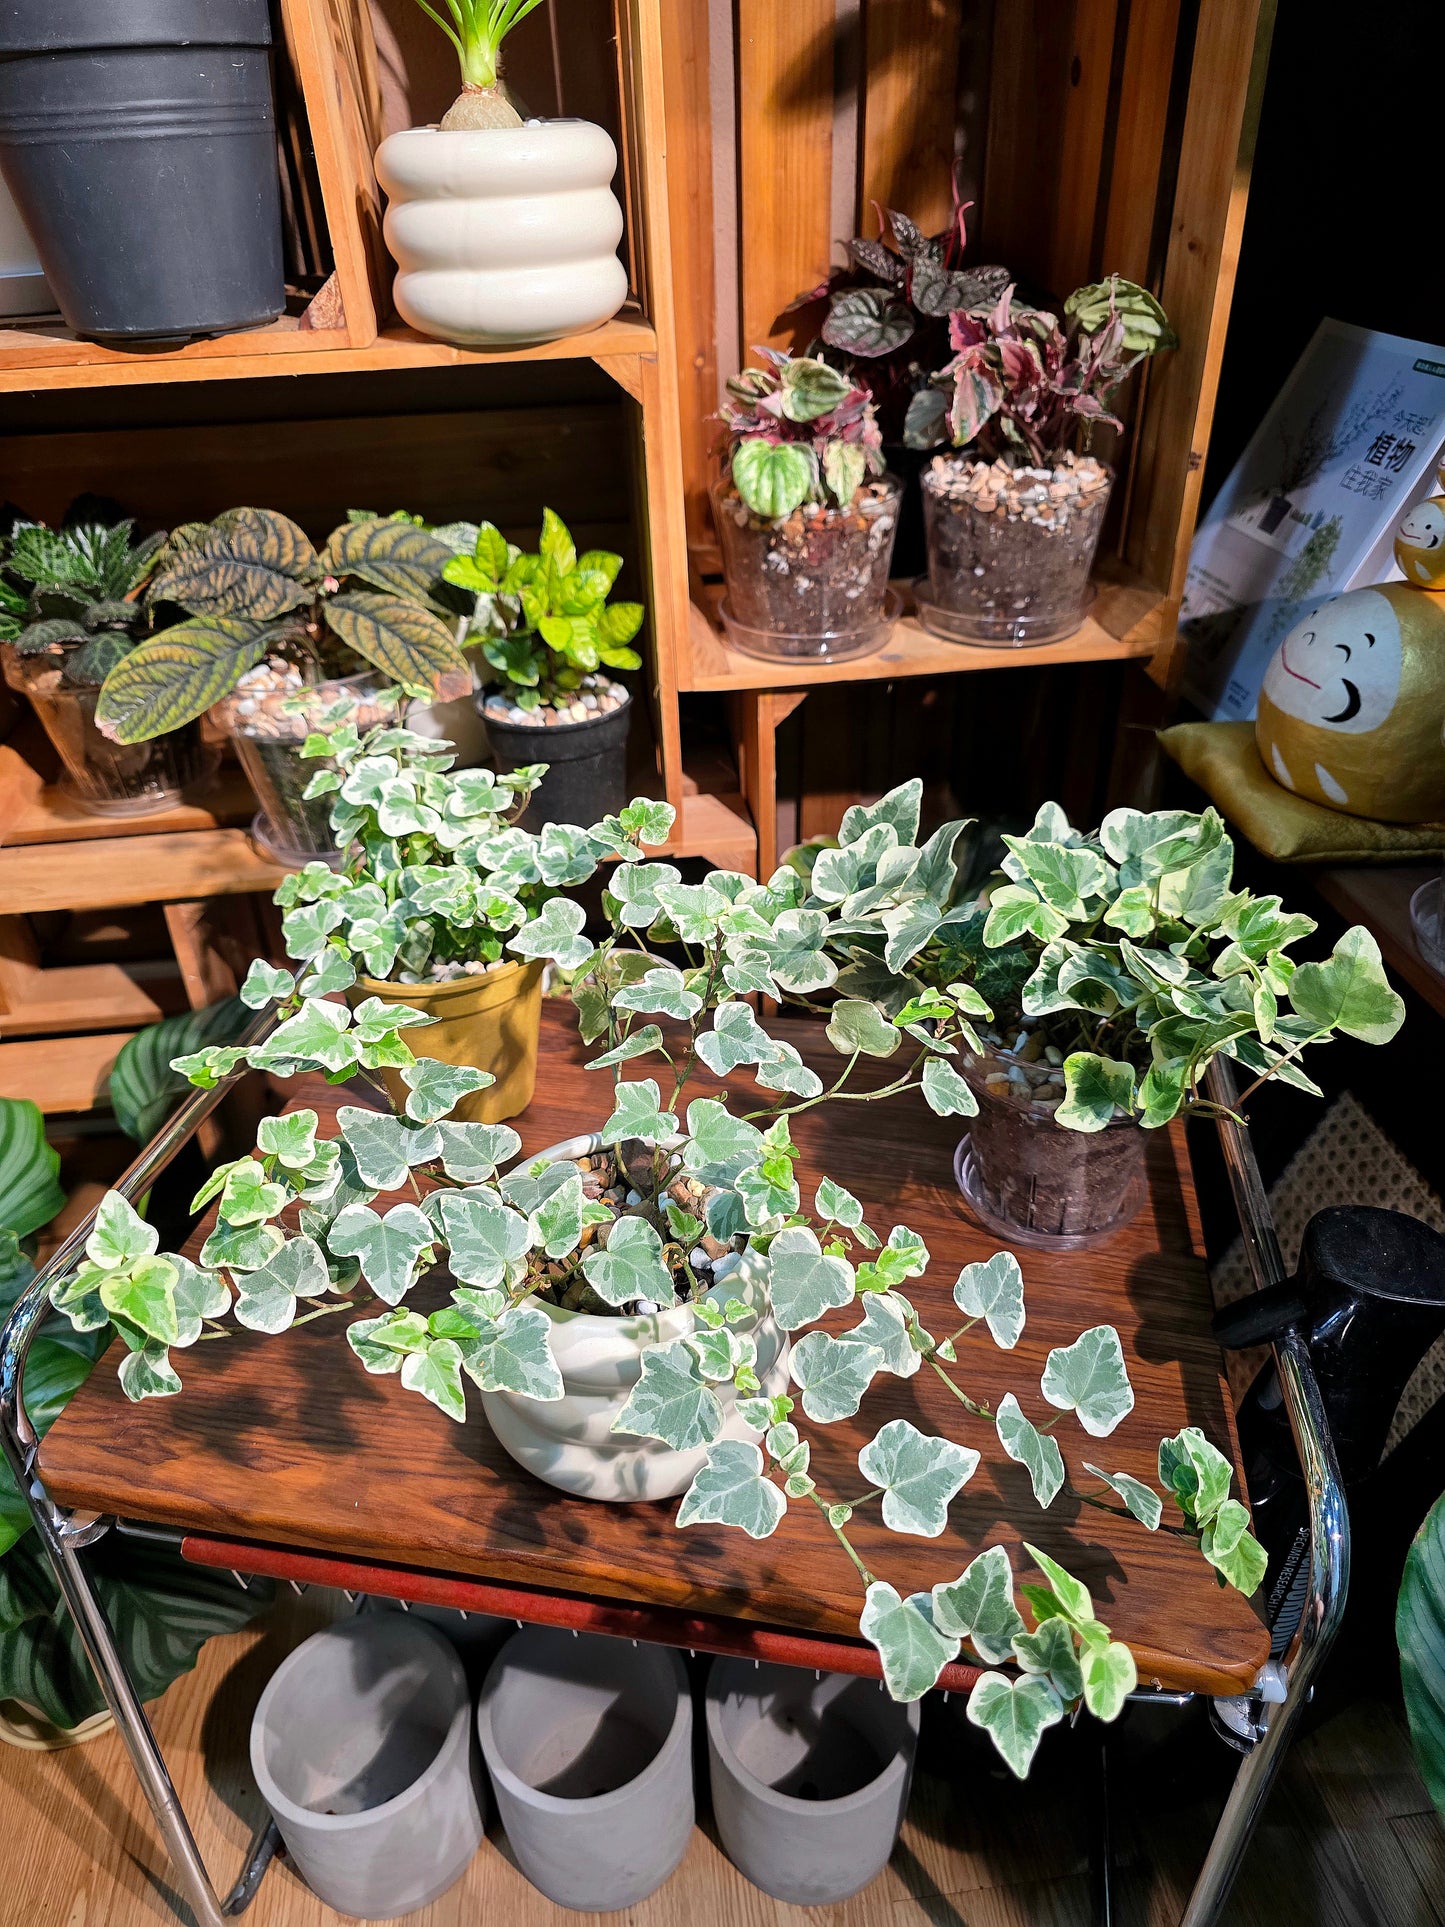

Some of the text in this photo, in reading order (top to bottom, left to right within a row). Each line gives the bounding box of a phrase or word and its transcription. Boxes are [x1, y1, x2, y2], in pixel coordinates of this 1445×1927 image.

[1363, 430, 1416, 473] 植物
[1339, 464, 1393, 501] 住我家
[1285, 1527, 1310, 1567] SPECIMEN
[1268, 1567, 1292, 1605] RESEARCH
